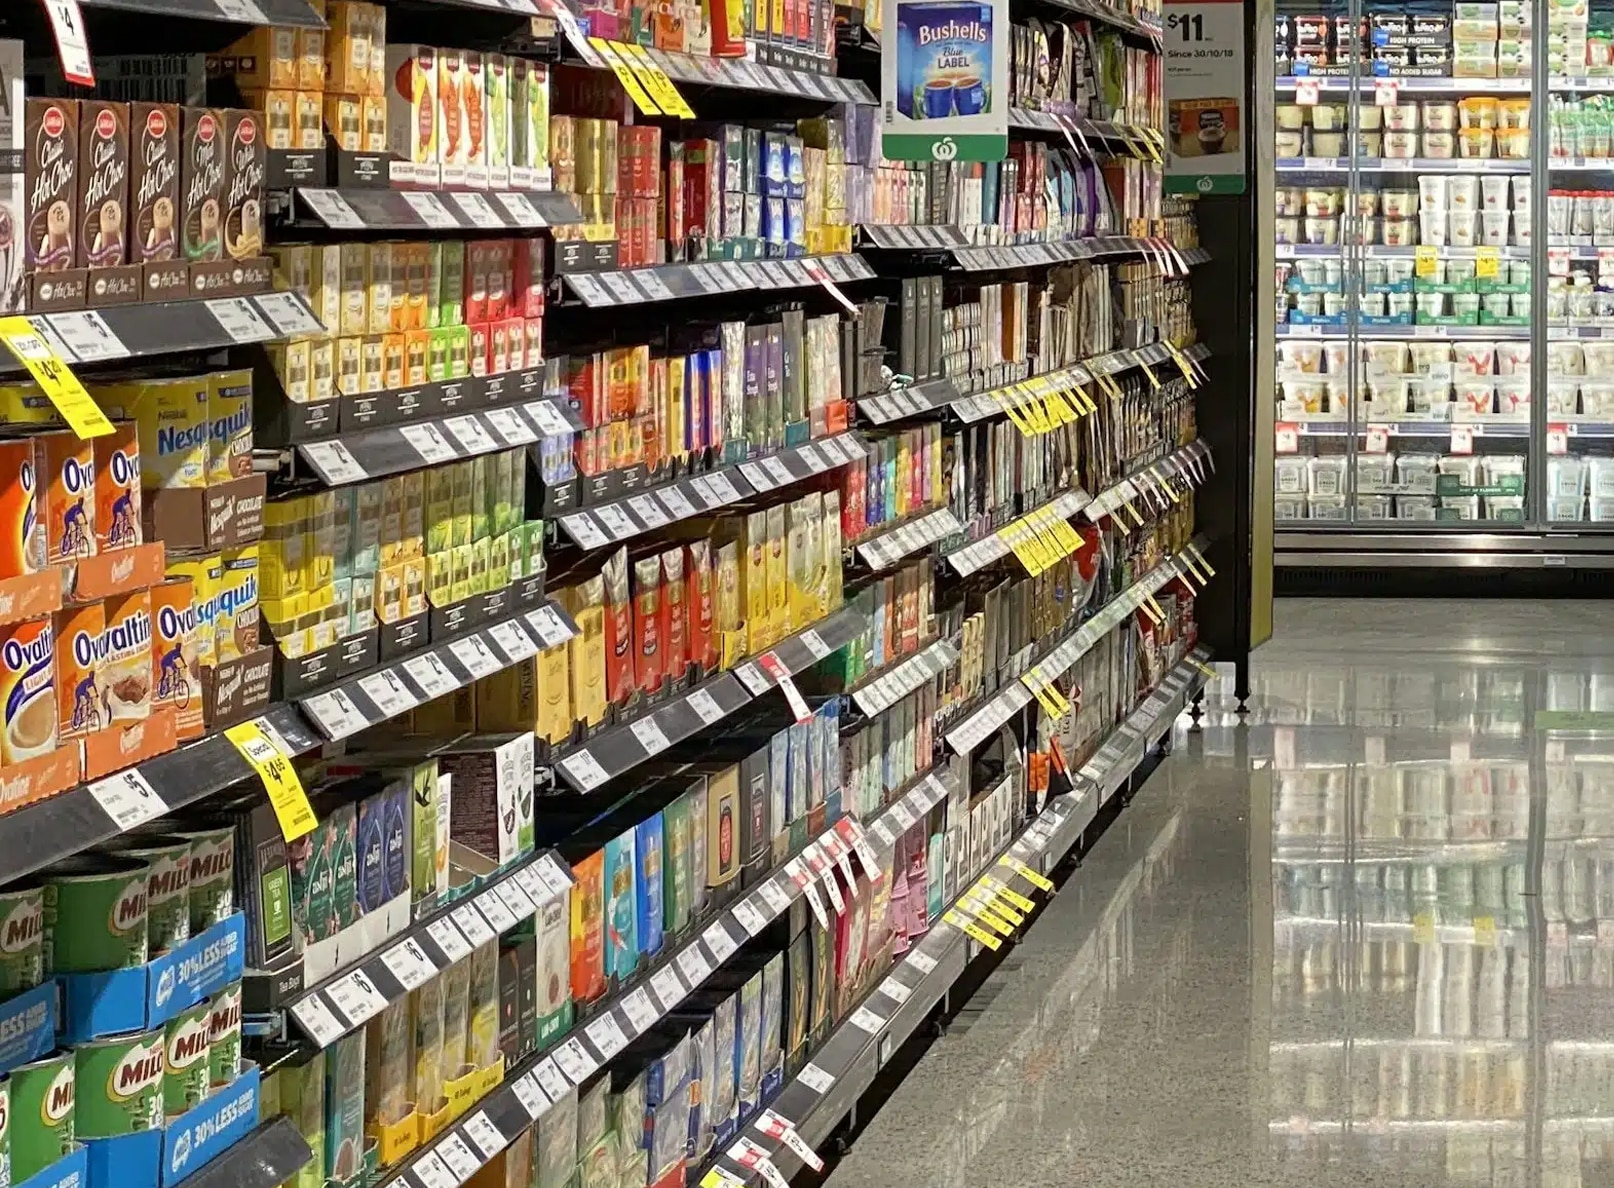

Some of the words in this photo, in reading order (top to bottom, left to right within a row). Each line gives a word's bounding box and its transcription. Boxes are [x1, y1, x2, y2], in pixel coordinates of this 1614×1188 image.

[919, 20, 987, 45] Bushells
[1168, 13, 1203, 41] $11
[1389, 36, 1406, 44] HIGH
[1408, 36, 1435, 44] PROTEIN
[942, 46, 964, 57] Blue
[1168, 49, 1192, 58] Since
[937, 56, 970, 69] LABEL
[1309, 68, 1327, 76] HIGH
[1327, 68, 1349, 76] PROTEI
[1389, 68, 1399, 76] NO
[1400, 68, 1421, 76] ADDED
[1422, 68, 1442, 76] SUGAR
[122, 772, 150, 798] $5
[351, 972, 373, 994] $6
[215, 1099, 237, 1132] LESS
